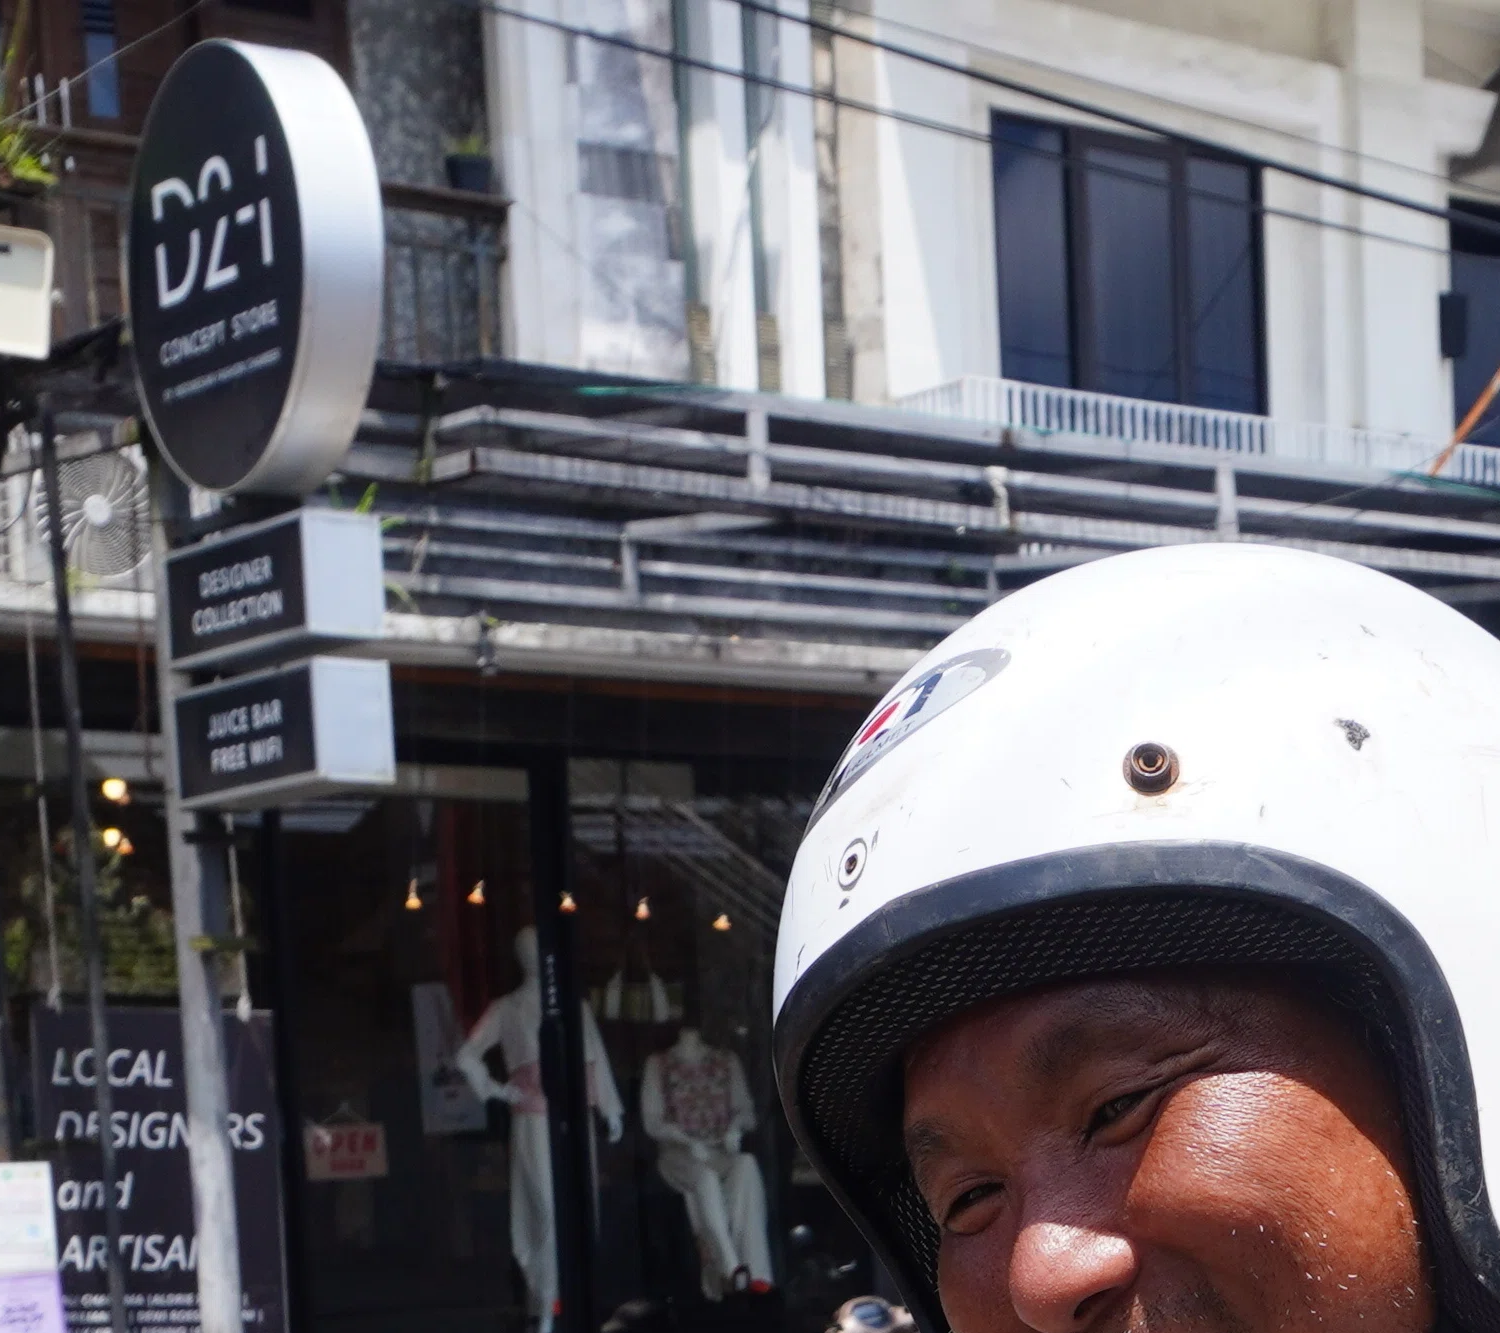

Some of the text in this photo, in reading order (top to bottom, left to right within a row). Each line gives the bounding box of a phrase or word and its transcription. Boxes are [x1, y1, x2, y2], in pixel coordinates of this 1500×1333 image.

[160, 299, 279, 368] CONCEPT STORE
[198, 555, 272, 599] DESIGNER
[192, 589, 284, 636] COLLECTION
[207, 698, 283, 741] JUICE BAR
[210, 735, 284, 775] FREE WIFI
[51, 1048, 174, 1088] LOCAL
